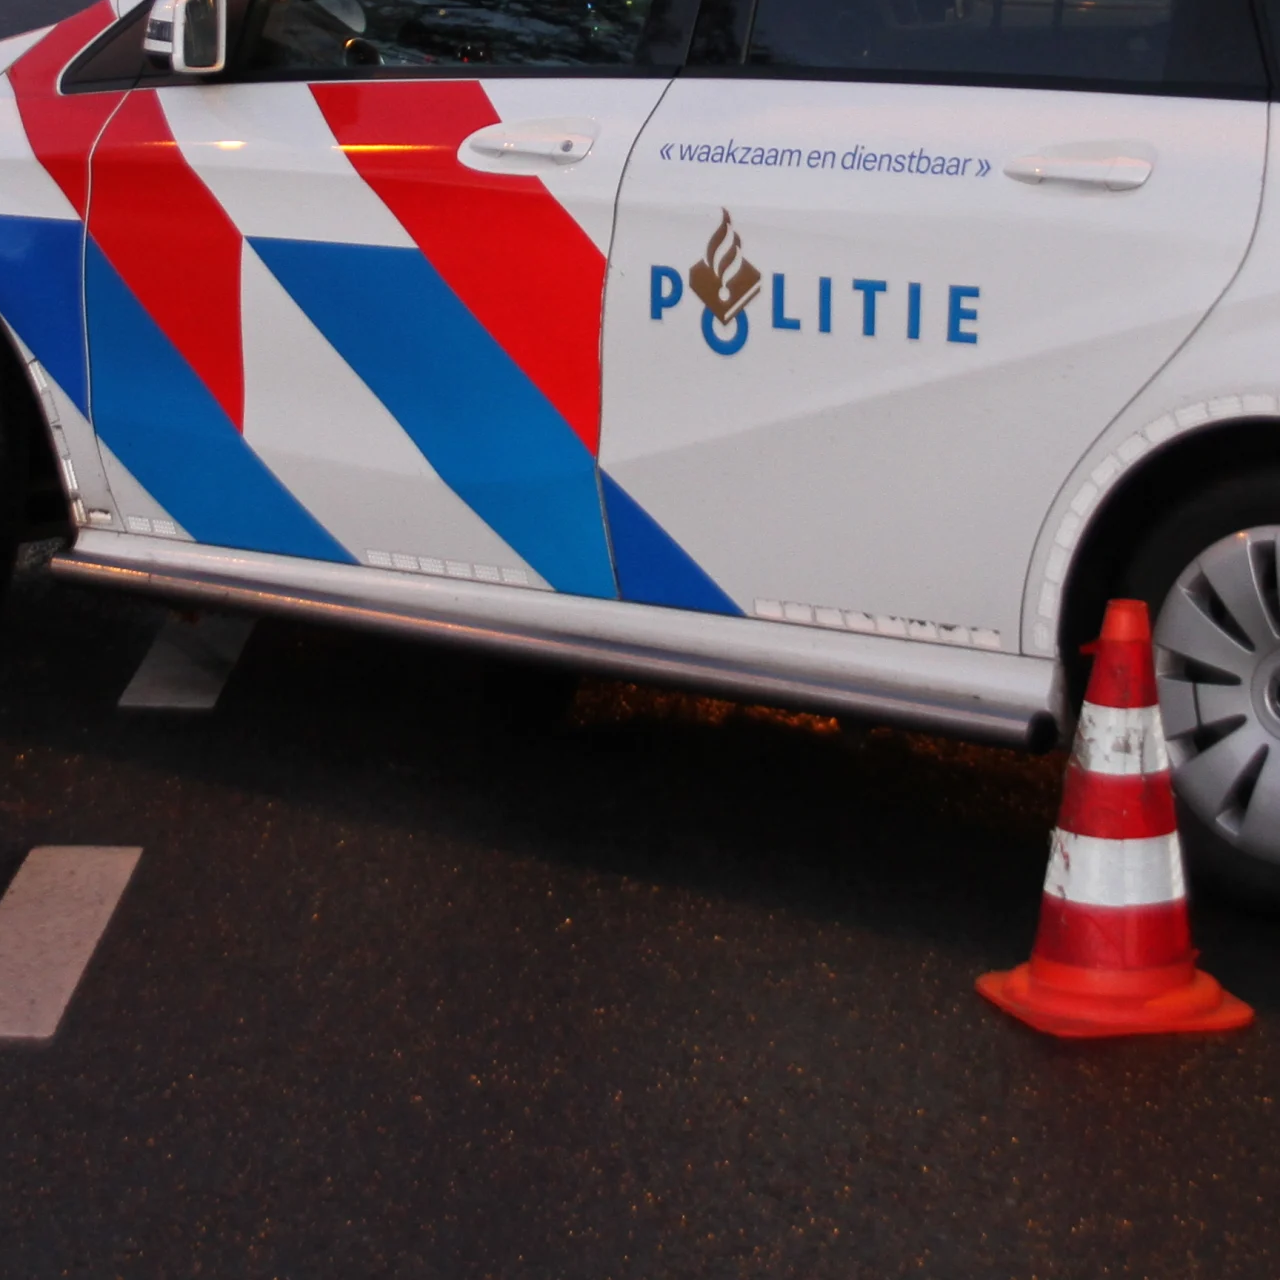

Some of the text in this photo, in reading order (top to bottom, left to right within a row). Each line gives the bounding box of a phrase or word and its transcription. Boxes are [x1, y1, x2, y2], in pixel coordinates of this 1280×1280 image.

[678, 139, 802, 169] waakzaam
[806, 149, 836, 170] en
[841, 144, 973, 177] dienstbaar
[650, 265, 980, 356] POLITIE
